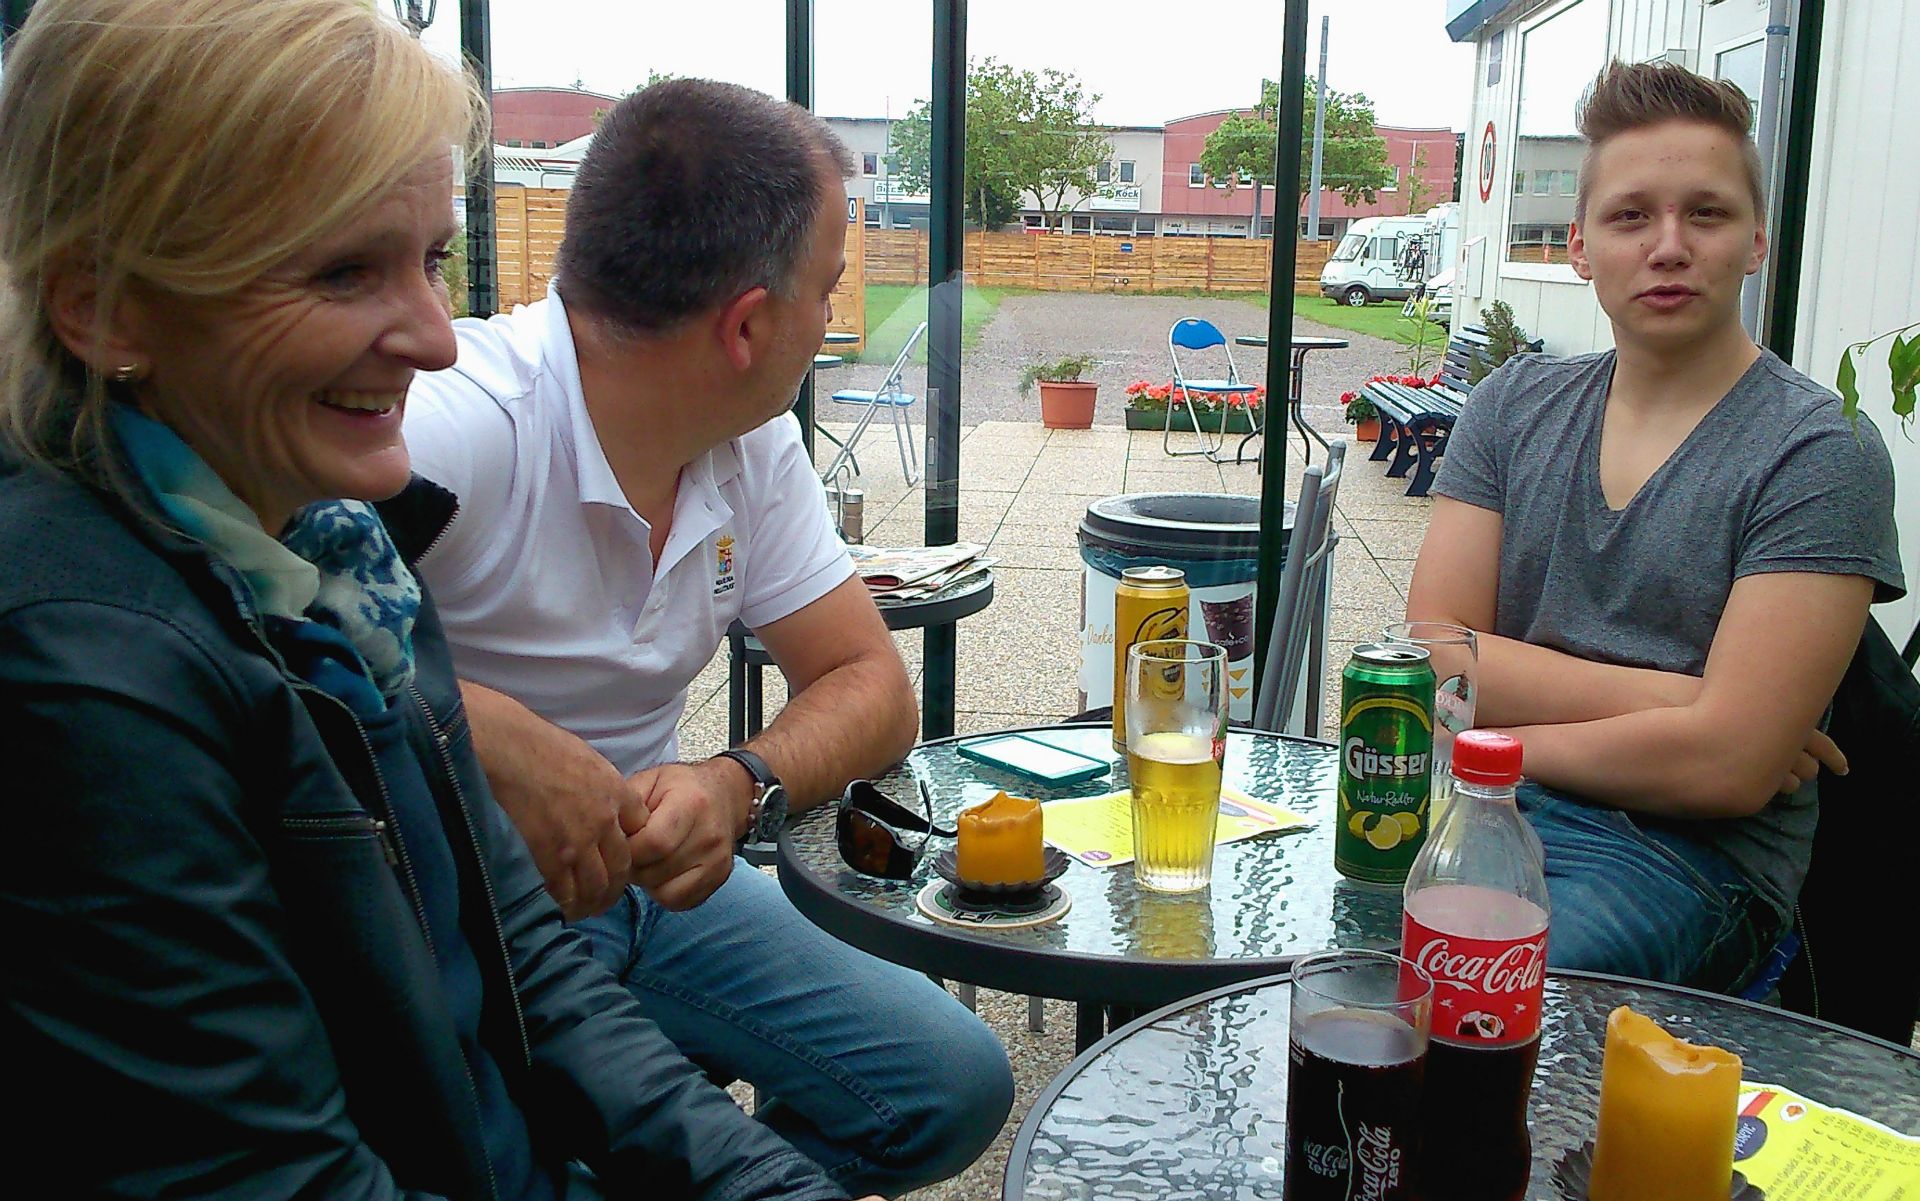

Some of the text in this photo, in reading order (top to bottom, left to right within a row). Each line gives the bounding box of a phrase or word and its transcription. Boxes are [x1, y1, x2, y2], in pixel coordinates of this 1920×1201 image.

[1115, 188, 1139, 198] Köck
[1344, 736, 1428, 780] Gösser
[1412, 937, 1546, 994] Coca-Cola
[1388, 1148, 1401, 1189] zero
